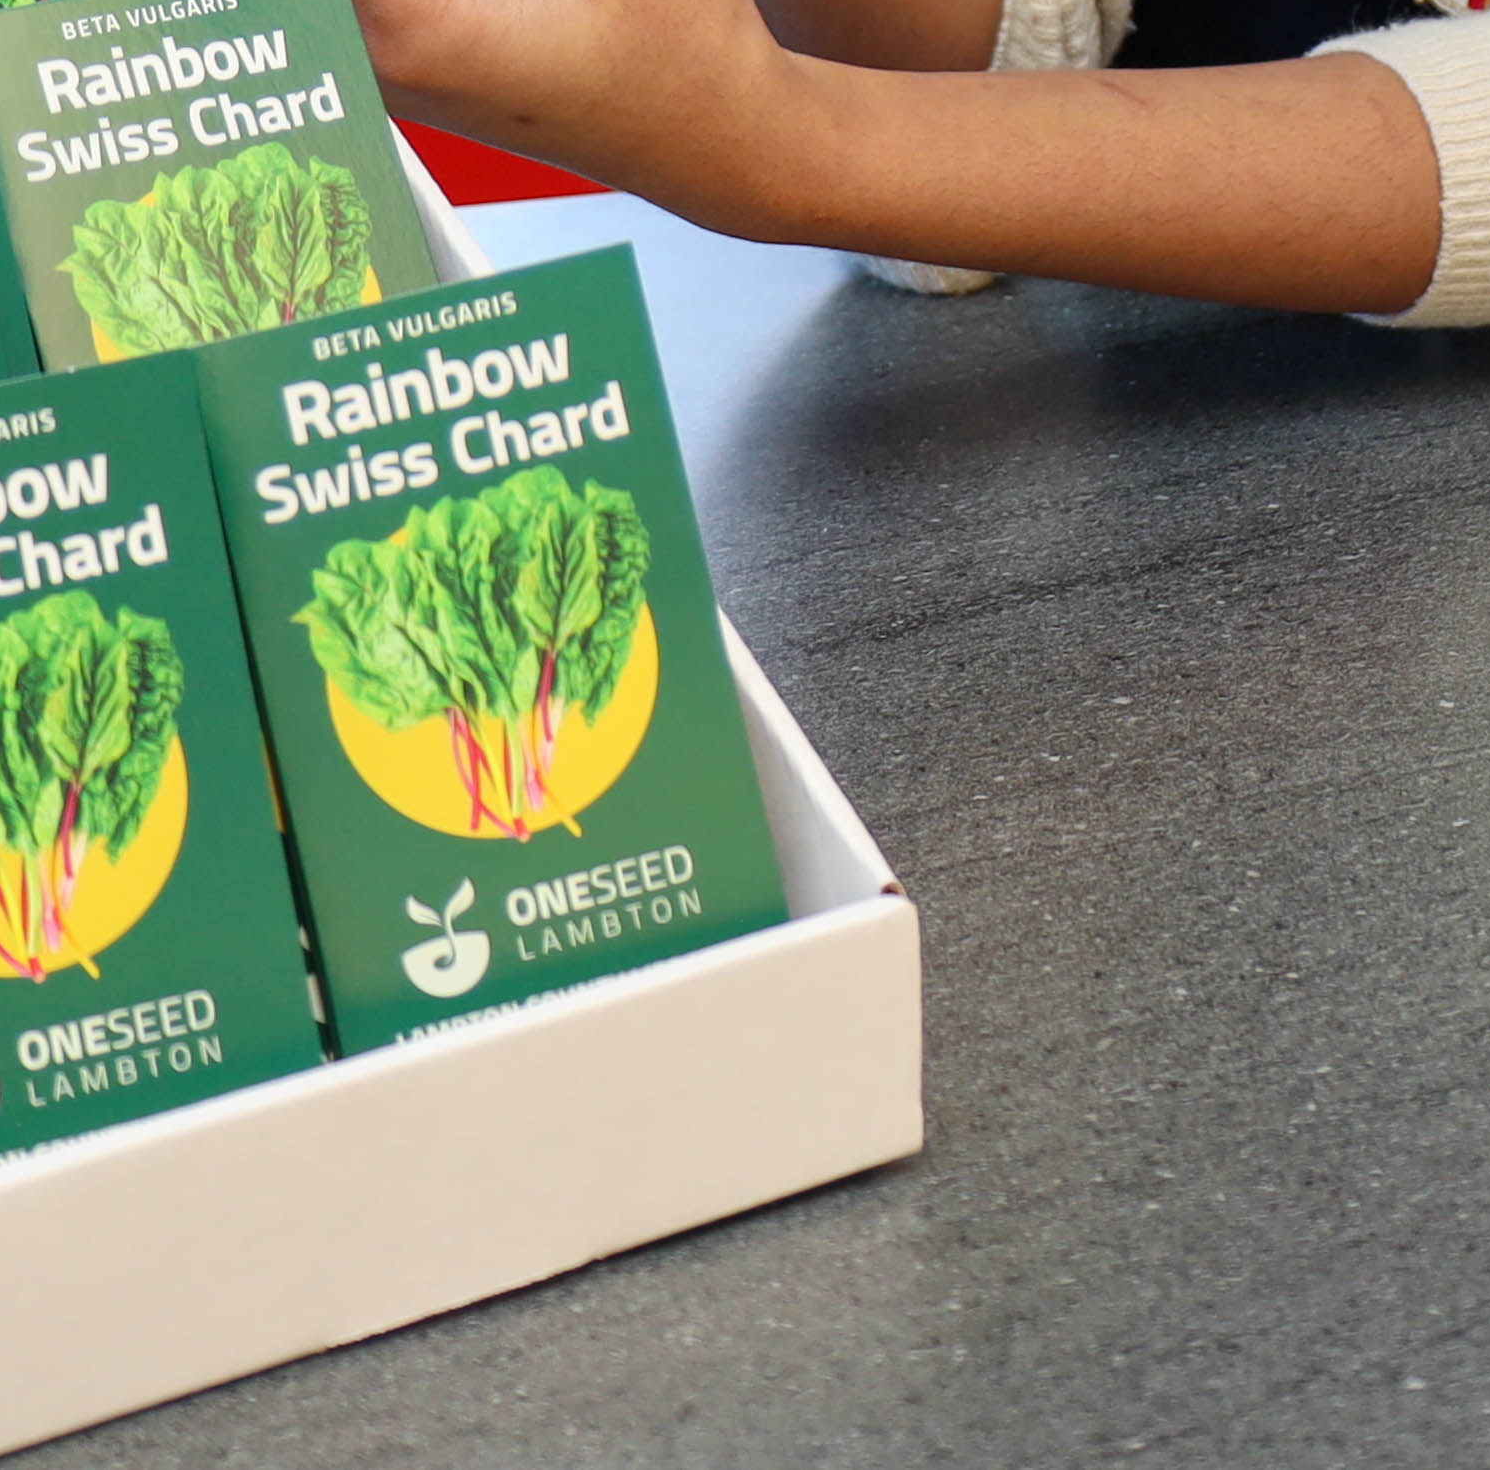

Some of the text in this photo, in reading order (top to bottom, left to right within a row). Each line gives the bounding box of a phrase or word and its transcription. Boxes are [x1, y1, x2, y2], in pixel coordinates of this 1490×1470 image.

[60, 12, 122, 42] BETA
[36, 29, 289, 115] Rainbow
[16, 71, 346, 183] Swiss Chard
[313, 291, 518, 361] BETA VULGARIS
[282, 333, 570, 446] Rainbow
[255, 380, 631, 524] Swiss Chard
[505, 844, 694, 928] ONESEED
[516, 888, 702, 962] LAMBTON
[17, 989, 216, 1072] ONESEED
[27, 1036, 223, 1108] LAMBTON
